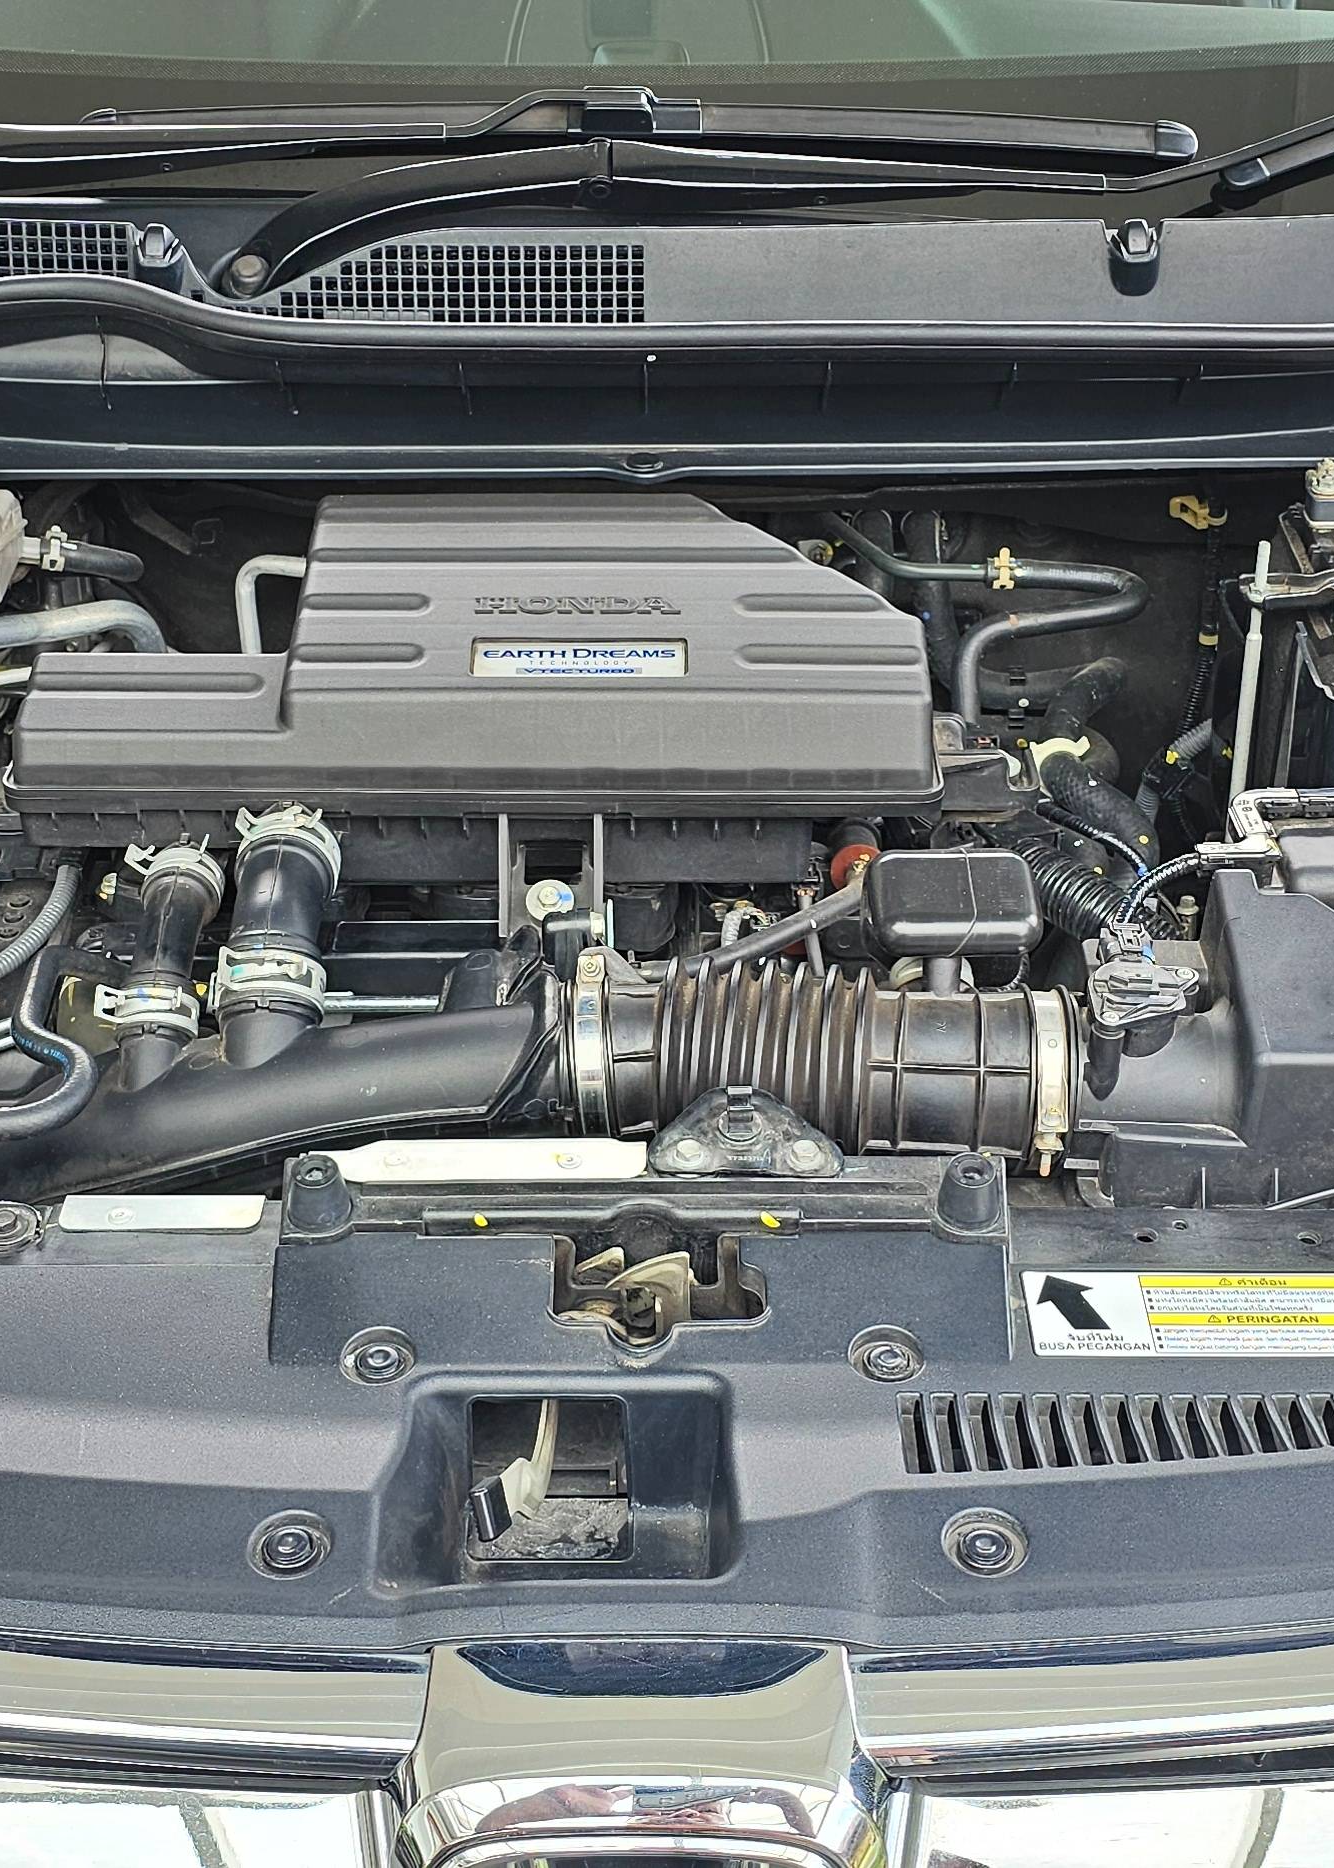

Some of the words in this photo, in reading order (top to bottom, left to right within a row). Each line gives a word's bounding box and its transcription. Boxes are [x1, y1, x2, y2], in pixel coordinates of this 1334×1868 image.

[474, 596, 682, 615] HONDA
[483, 648, 567, 659] EARTH
[573, 647, 676, 659] DREAMS
[1226, 1315, 1320, 1325] PERINGATAN
[1038, 1342, 1075, 1351] BUSA
[1078, 1342, 1151, 1351] PEGANGAN
